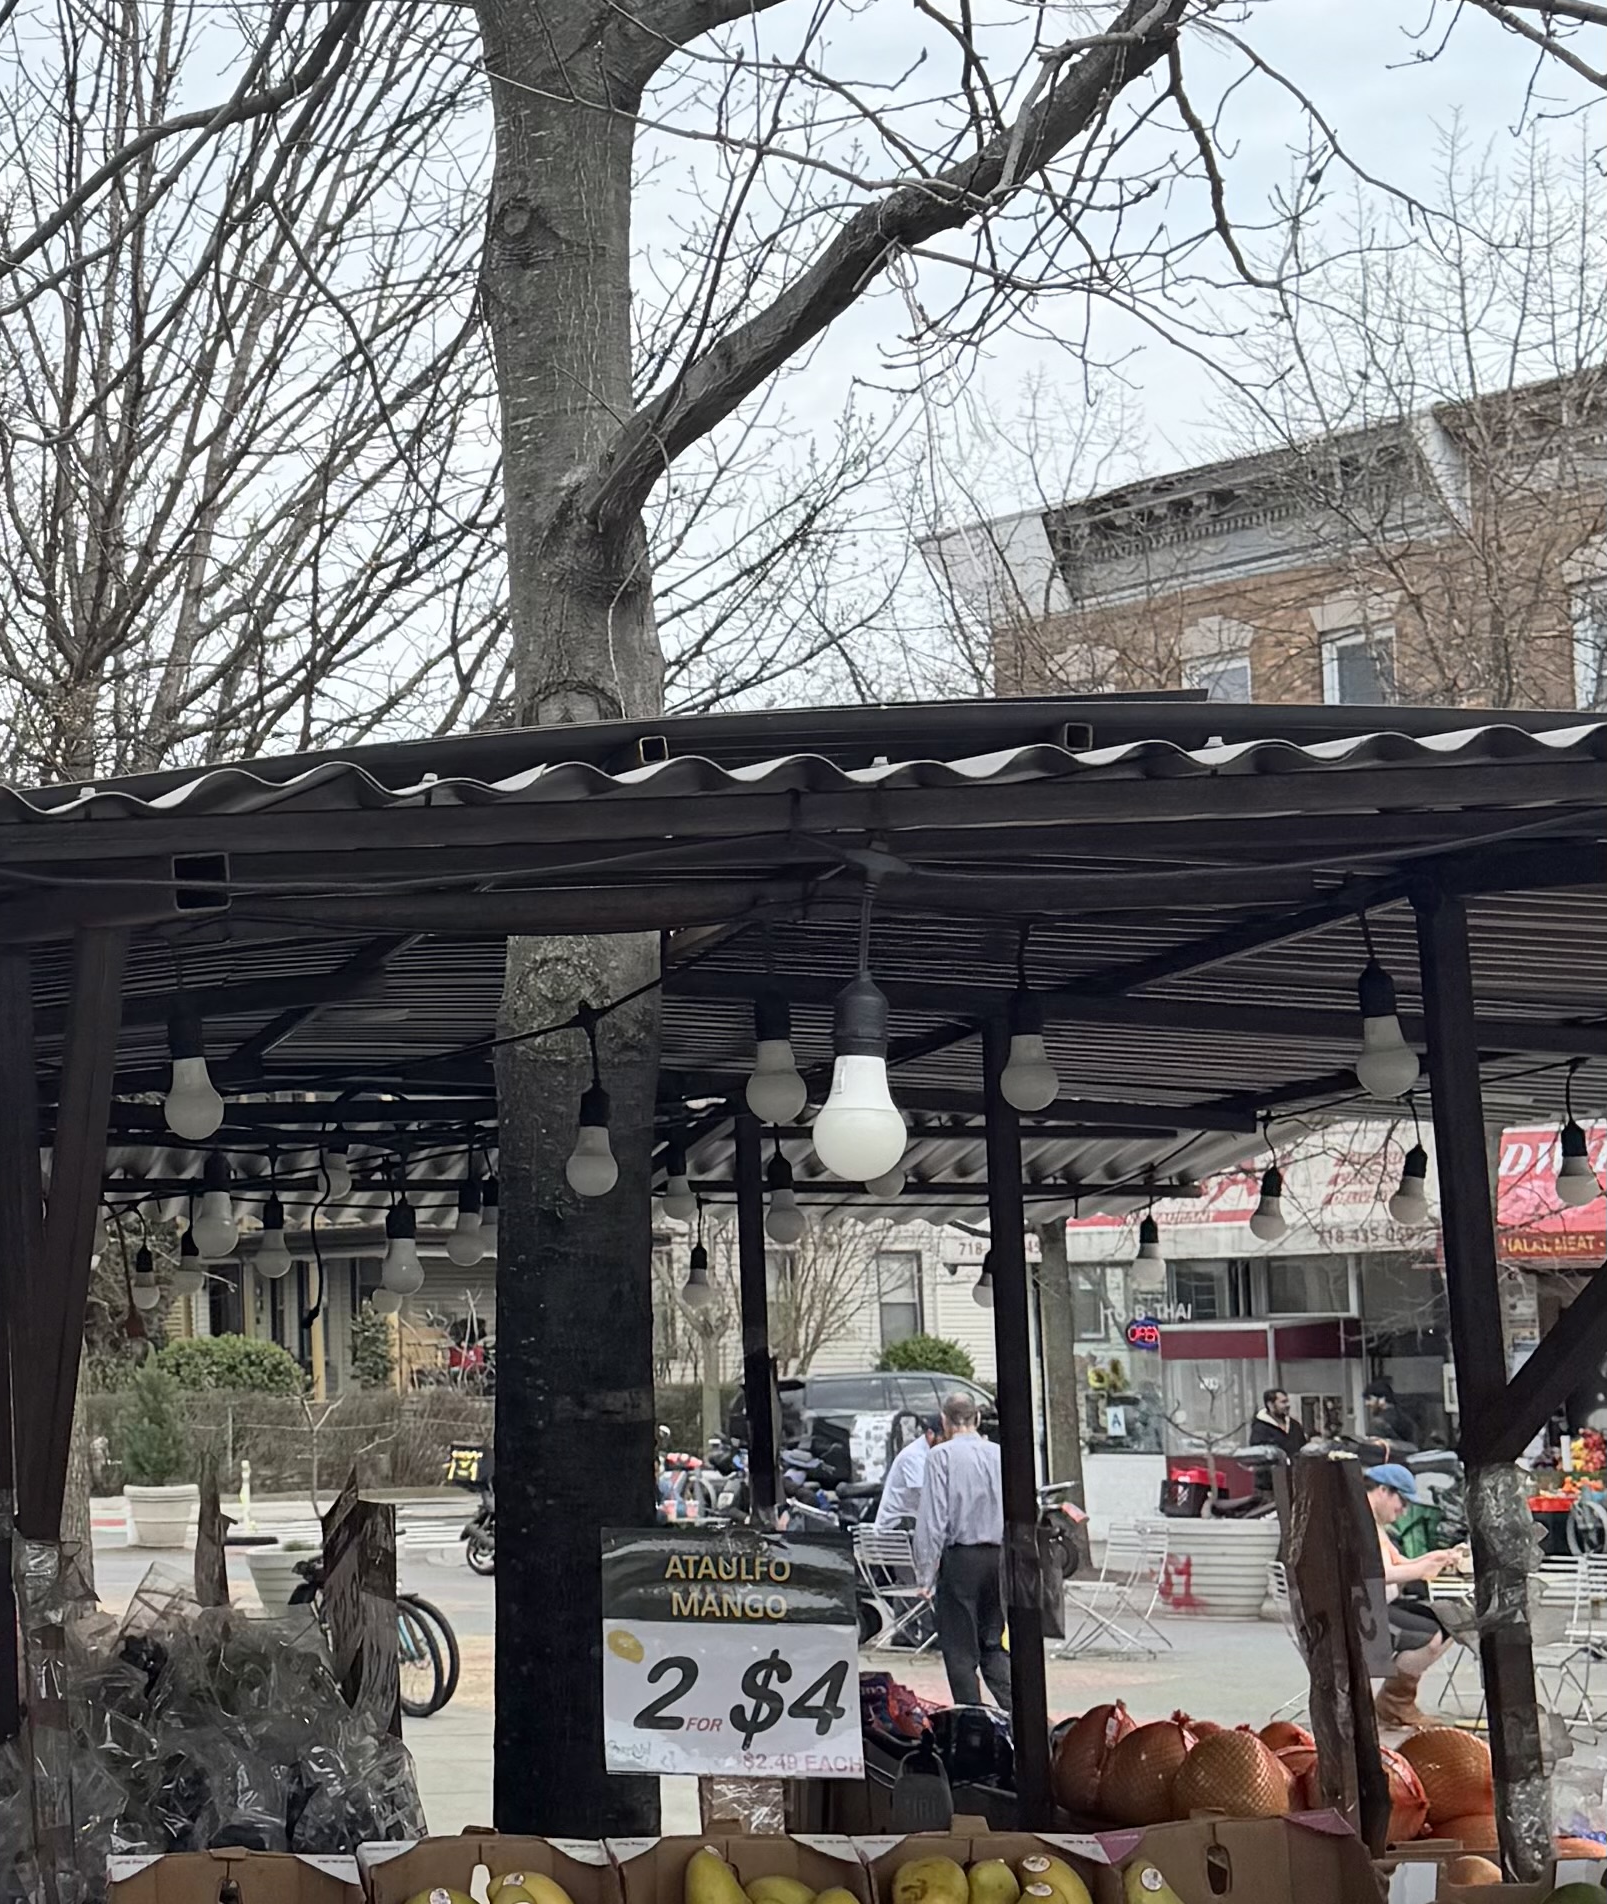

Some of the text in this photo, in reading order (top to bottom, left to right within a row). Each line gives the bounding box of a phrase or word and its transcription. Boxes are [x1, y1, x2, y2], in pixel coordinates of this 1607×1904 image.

[664, 1554, 791, 1582] ATAULFO
[670, 1592, 787, 1619] MANGO
[633, 1648, 849, 1752] 2 FOR $4
[744, 1754, 864, 1774] $2.49 EACH
